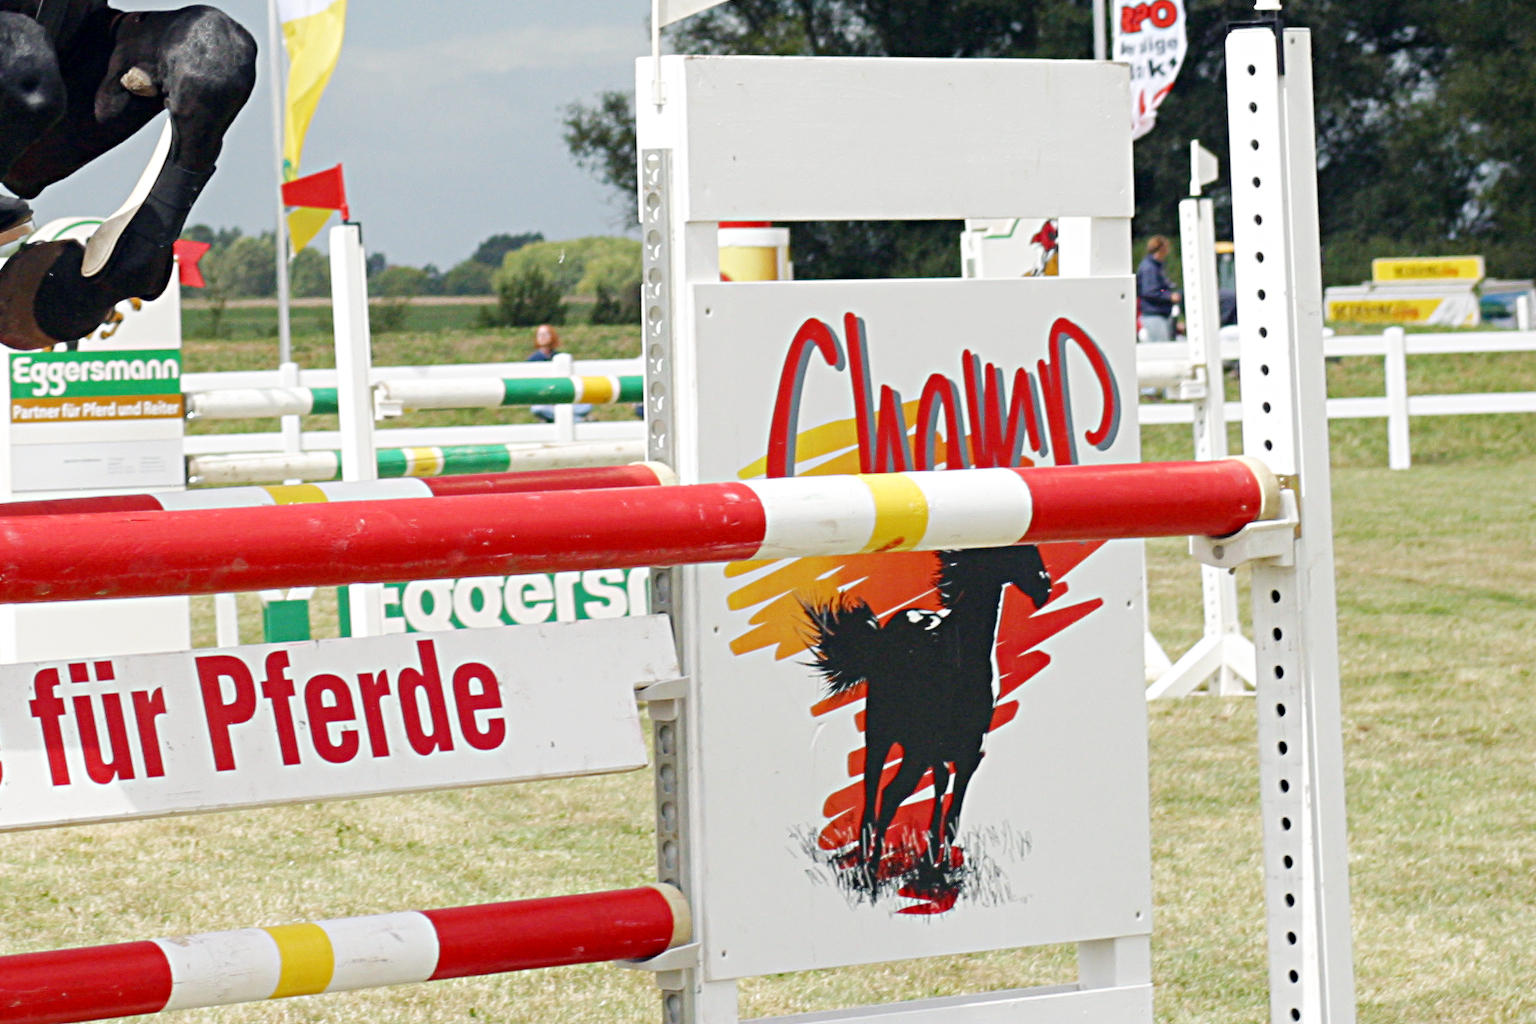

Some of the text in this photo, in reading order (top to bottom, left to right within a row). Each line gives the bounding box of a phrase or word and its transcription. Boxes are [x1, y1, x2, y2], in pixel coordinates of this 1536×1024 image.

[12, 356, 180, 397] Eggersmann
[13, 400, 180, 419] Partner für Pferd und Reiter
[30, 660, 167, 786] für
[195, 639, 506, 772] Pferde
